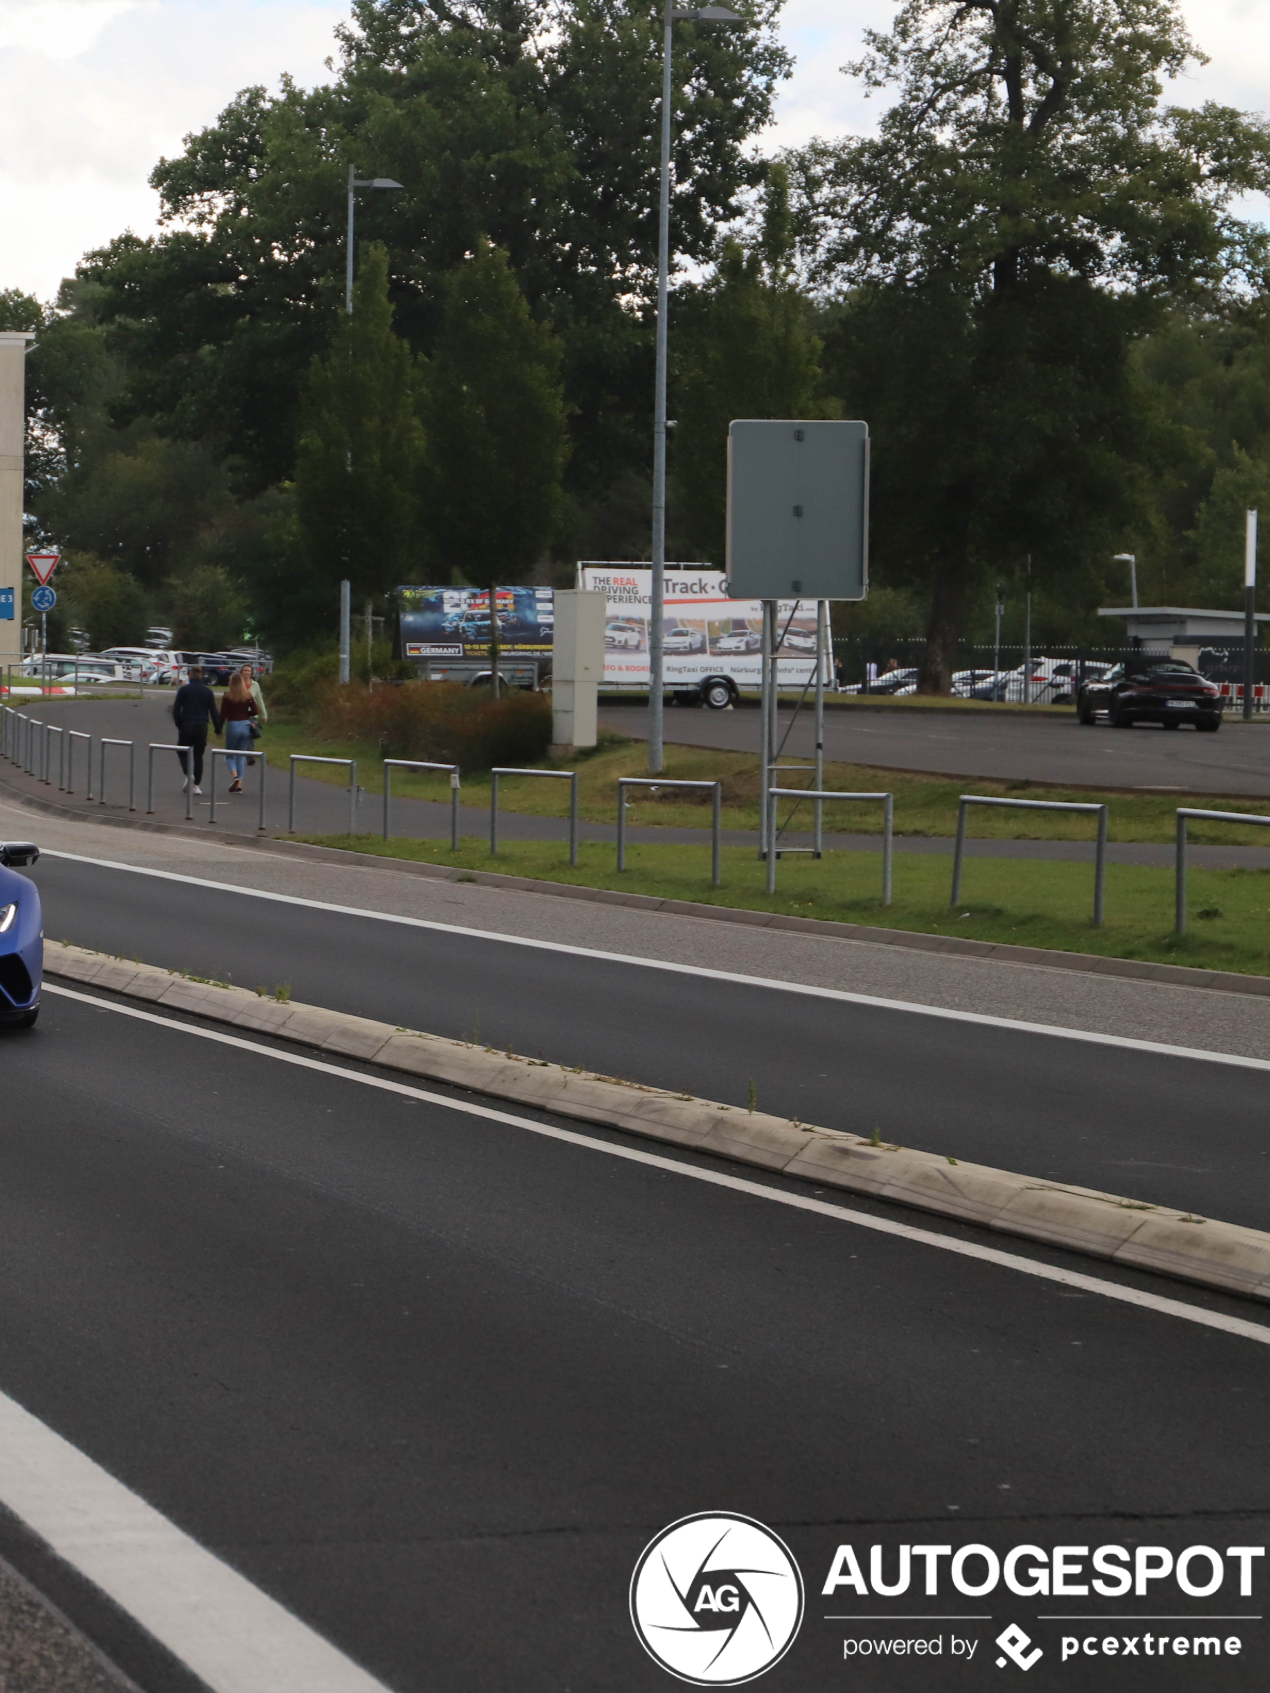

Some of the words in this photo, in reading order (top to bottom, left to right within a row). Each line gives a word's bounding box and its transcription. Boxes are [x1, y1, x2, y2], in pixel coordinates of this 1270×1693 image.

[592, 576, 611, 586] THE
[613, 577, 638, 586] REAL
[663, 577, 709, 594] Track
[606, 595, 653, 604] PERIENCE
[666, 666, 698, 674] RingTaxi
